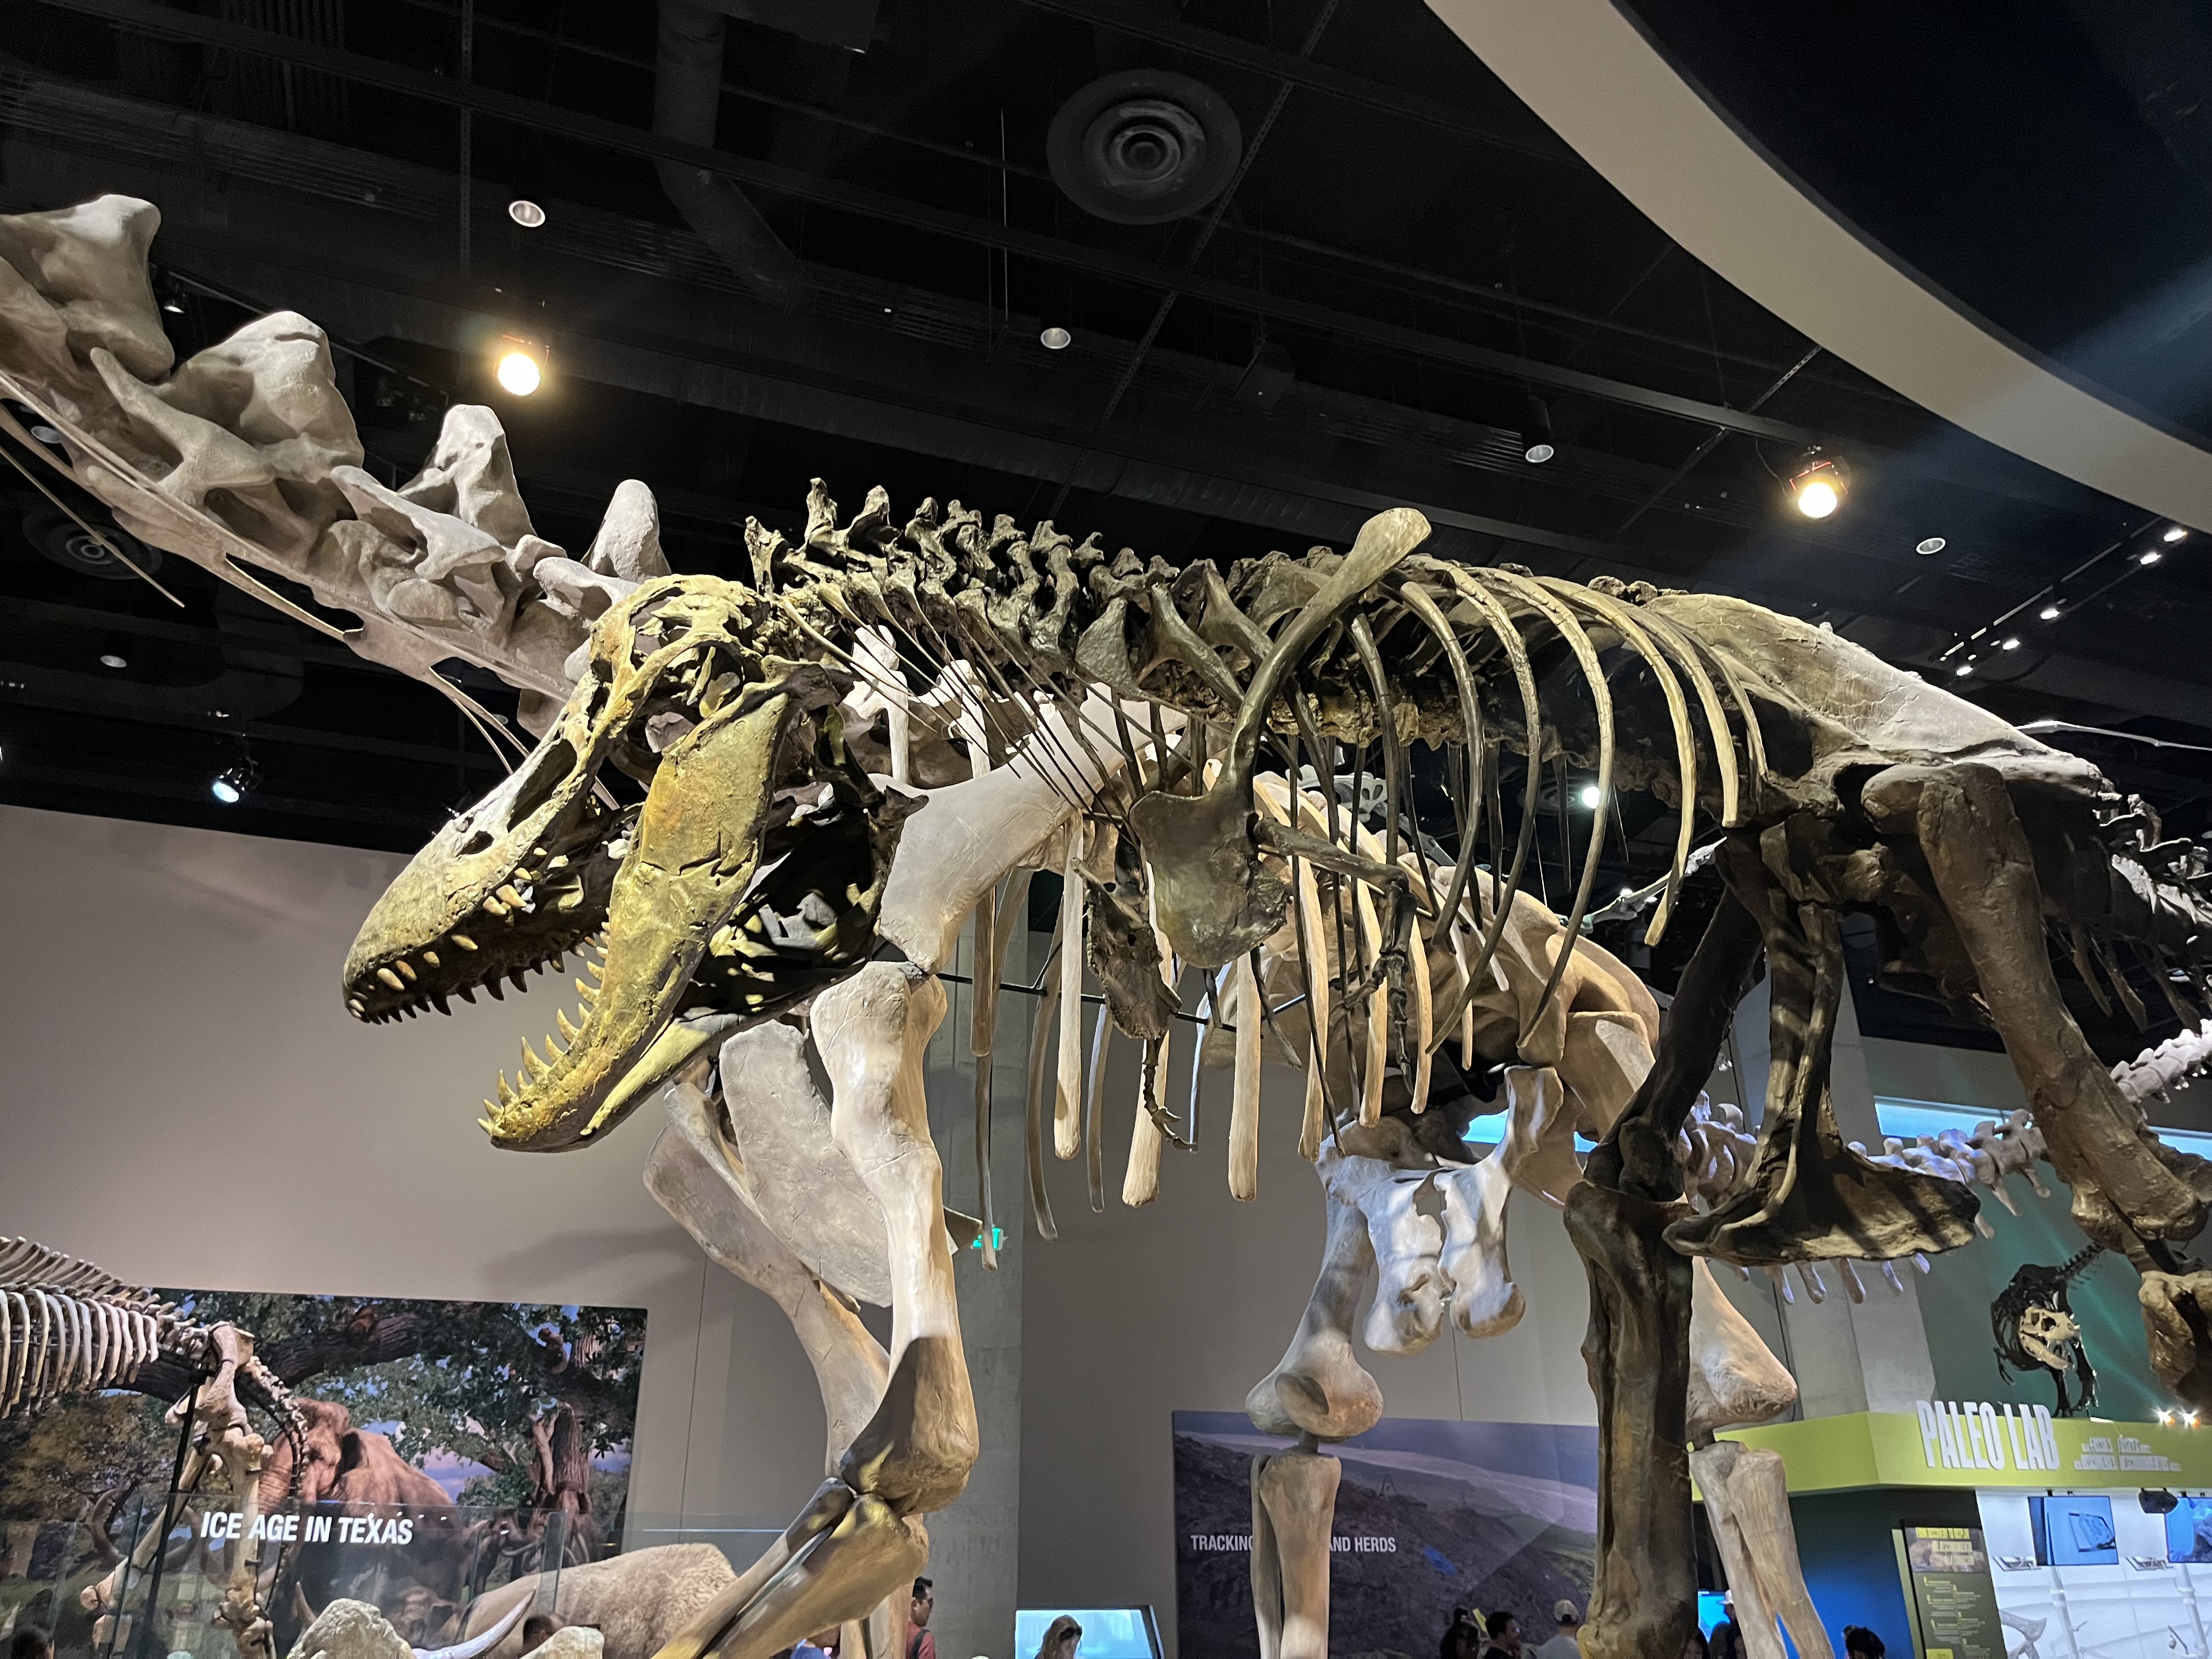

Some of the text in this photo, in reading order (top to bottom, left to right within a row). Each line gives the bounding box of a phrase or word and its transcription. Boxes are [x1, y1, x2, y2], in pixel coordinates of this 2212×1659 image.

[1916, 1400, 2059, 1470] PALEO LAB
[201, 1511, 413, 1544] ICE AGE IN TEXAS
[1330, 1536, 1351, 1551] ND
[1355, 1537, 1396, 1552] HERDS
